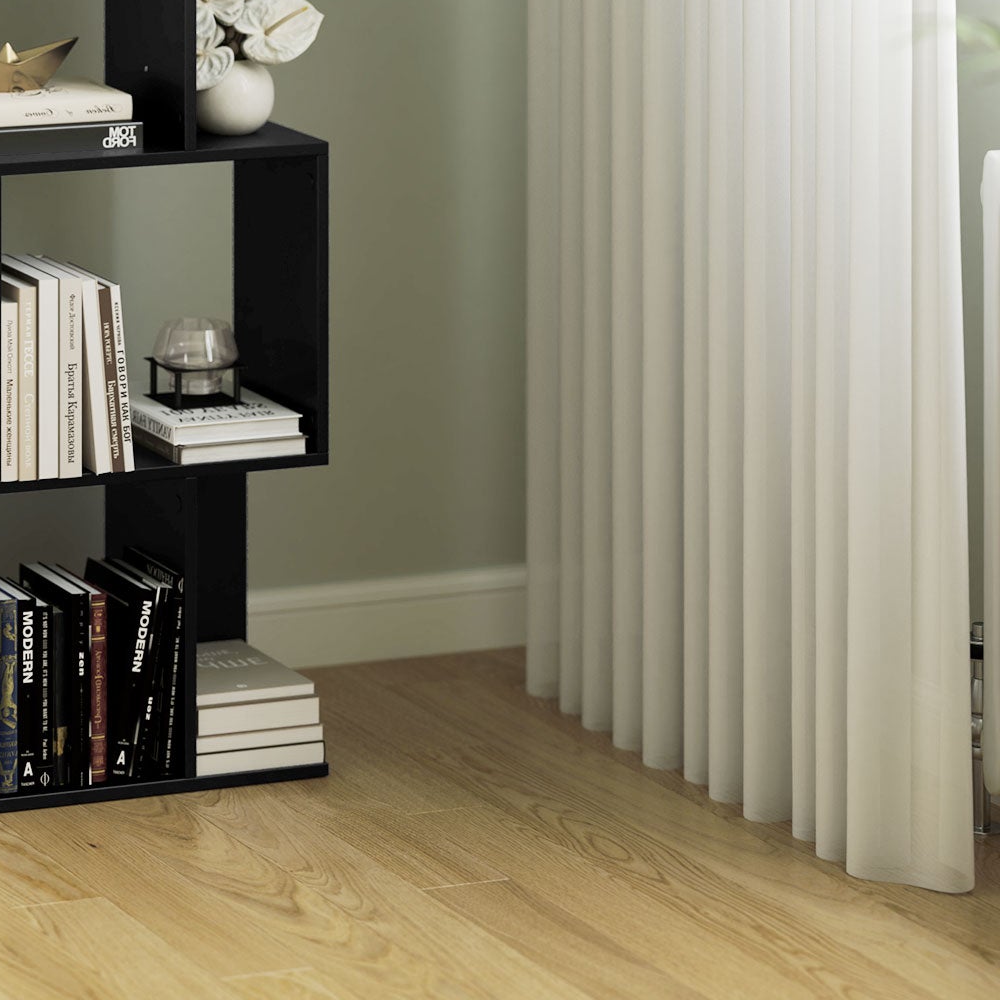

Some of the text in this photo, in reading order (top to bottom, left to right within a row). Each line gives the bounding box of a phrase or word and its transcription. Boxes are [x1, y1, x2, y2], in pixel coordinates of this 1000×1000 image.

[65, 363, 78, 399] Братья
[117, 350, 127, 398] ГОВОРИ
[6, 379, 14, 424] Маленькие
[106, 380, 117, 427] Бархатная
[120, 402, 129, 421] КАК
[6, 427, 14, 467] женщины
[65, 402, 78, 463] Карамазовы
[123, 425, 132, 444] БОГ
[22, 610, 33, 683] MODERN
[131, 600, 153, 673] MODERN
[145, 696, 154, 721] zen
[23, 761, 34, 776] A
[116, 750, 125, 765] A
